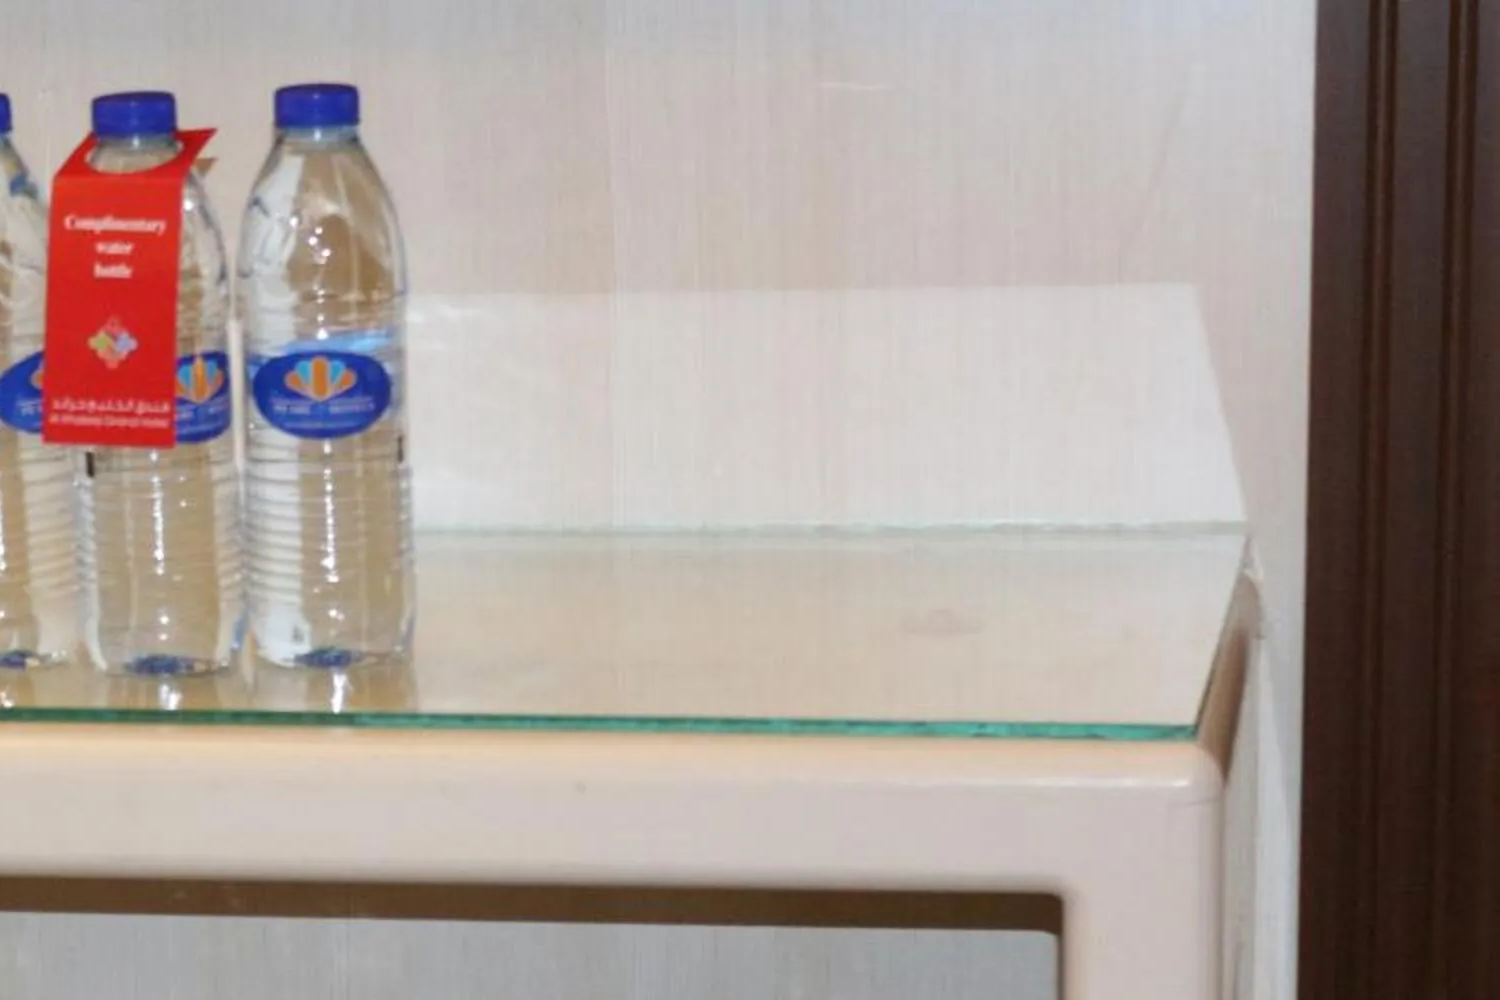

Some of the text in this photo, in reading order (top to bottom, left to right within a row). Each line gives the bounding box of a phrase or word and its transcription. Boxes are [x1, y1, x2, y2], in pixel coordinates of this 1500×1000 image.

[63, 214, 167, 236] Complimentary
[95, 241, 133, 255] water
[93, 260, 132, 279] bottle
